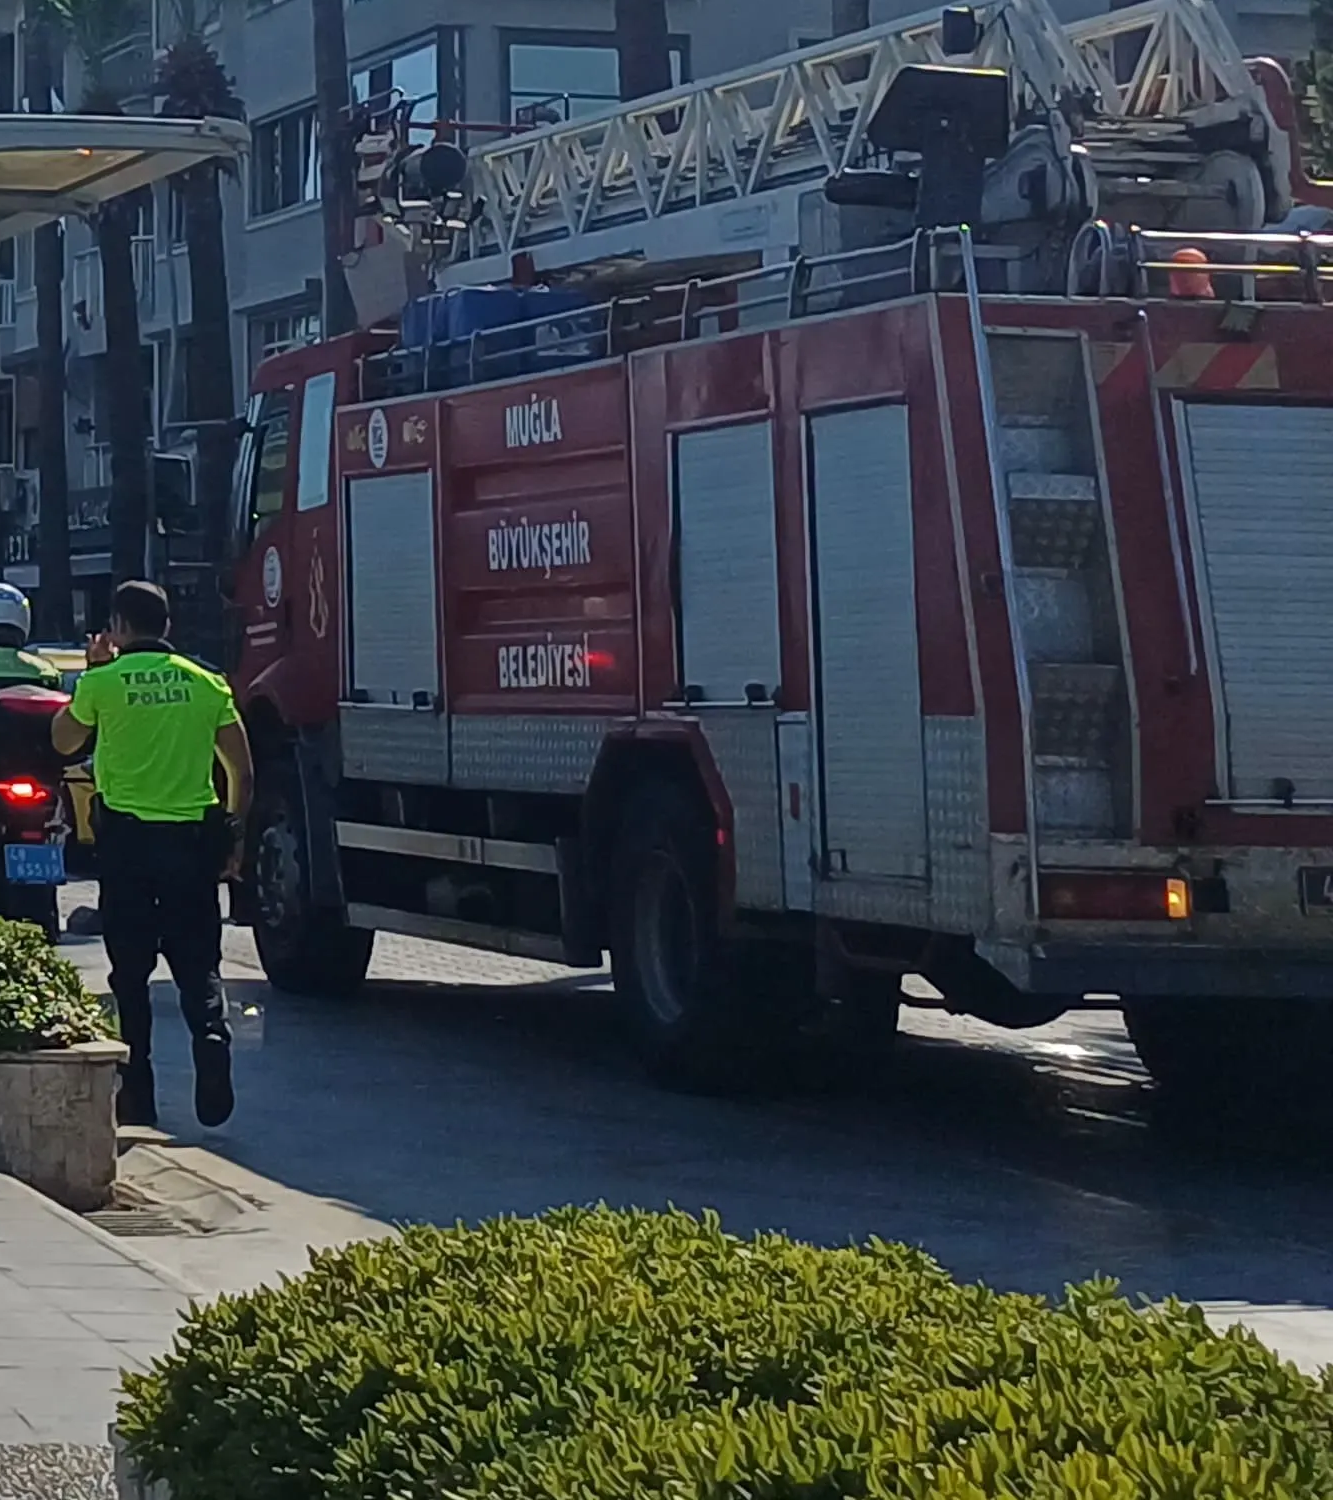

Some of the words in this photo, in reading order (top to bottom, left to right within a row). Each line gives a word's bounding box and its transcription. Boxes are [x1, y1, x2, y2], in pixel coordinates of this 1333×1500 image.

[505, 393, 563, 449] MUĞLA
[488, 510, 591, 580] BÜYÜKŞEHİR
[498, 631, 591, 689] BELEDİYESİ
